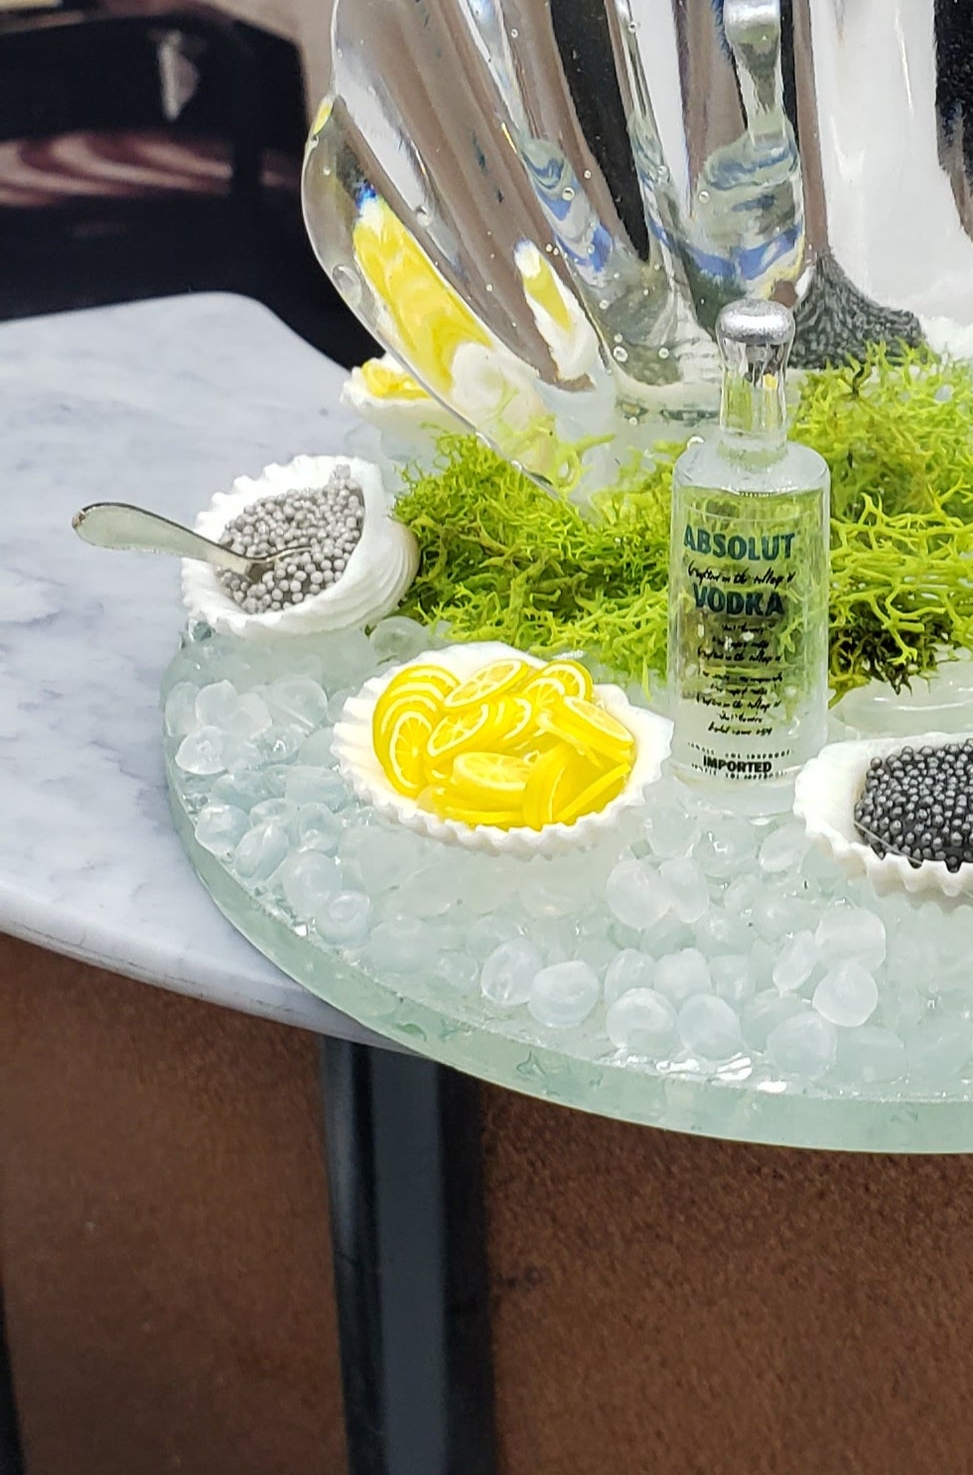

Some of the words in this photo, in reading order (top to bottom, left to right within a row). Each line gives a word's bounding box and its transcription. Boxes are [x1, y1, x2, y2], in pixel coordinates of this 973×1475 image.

[684, 524, 796, 561] ABSOLUT
[693, 582, 785, 617] VODKA
[703, 755, 772, 773] IMPORTED
